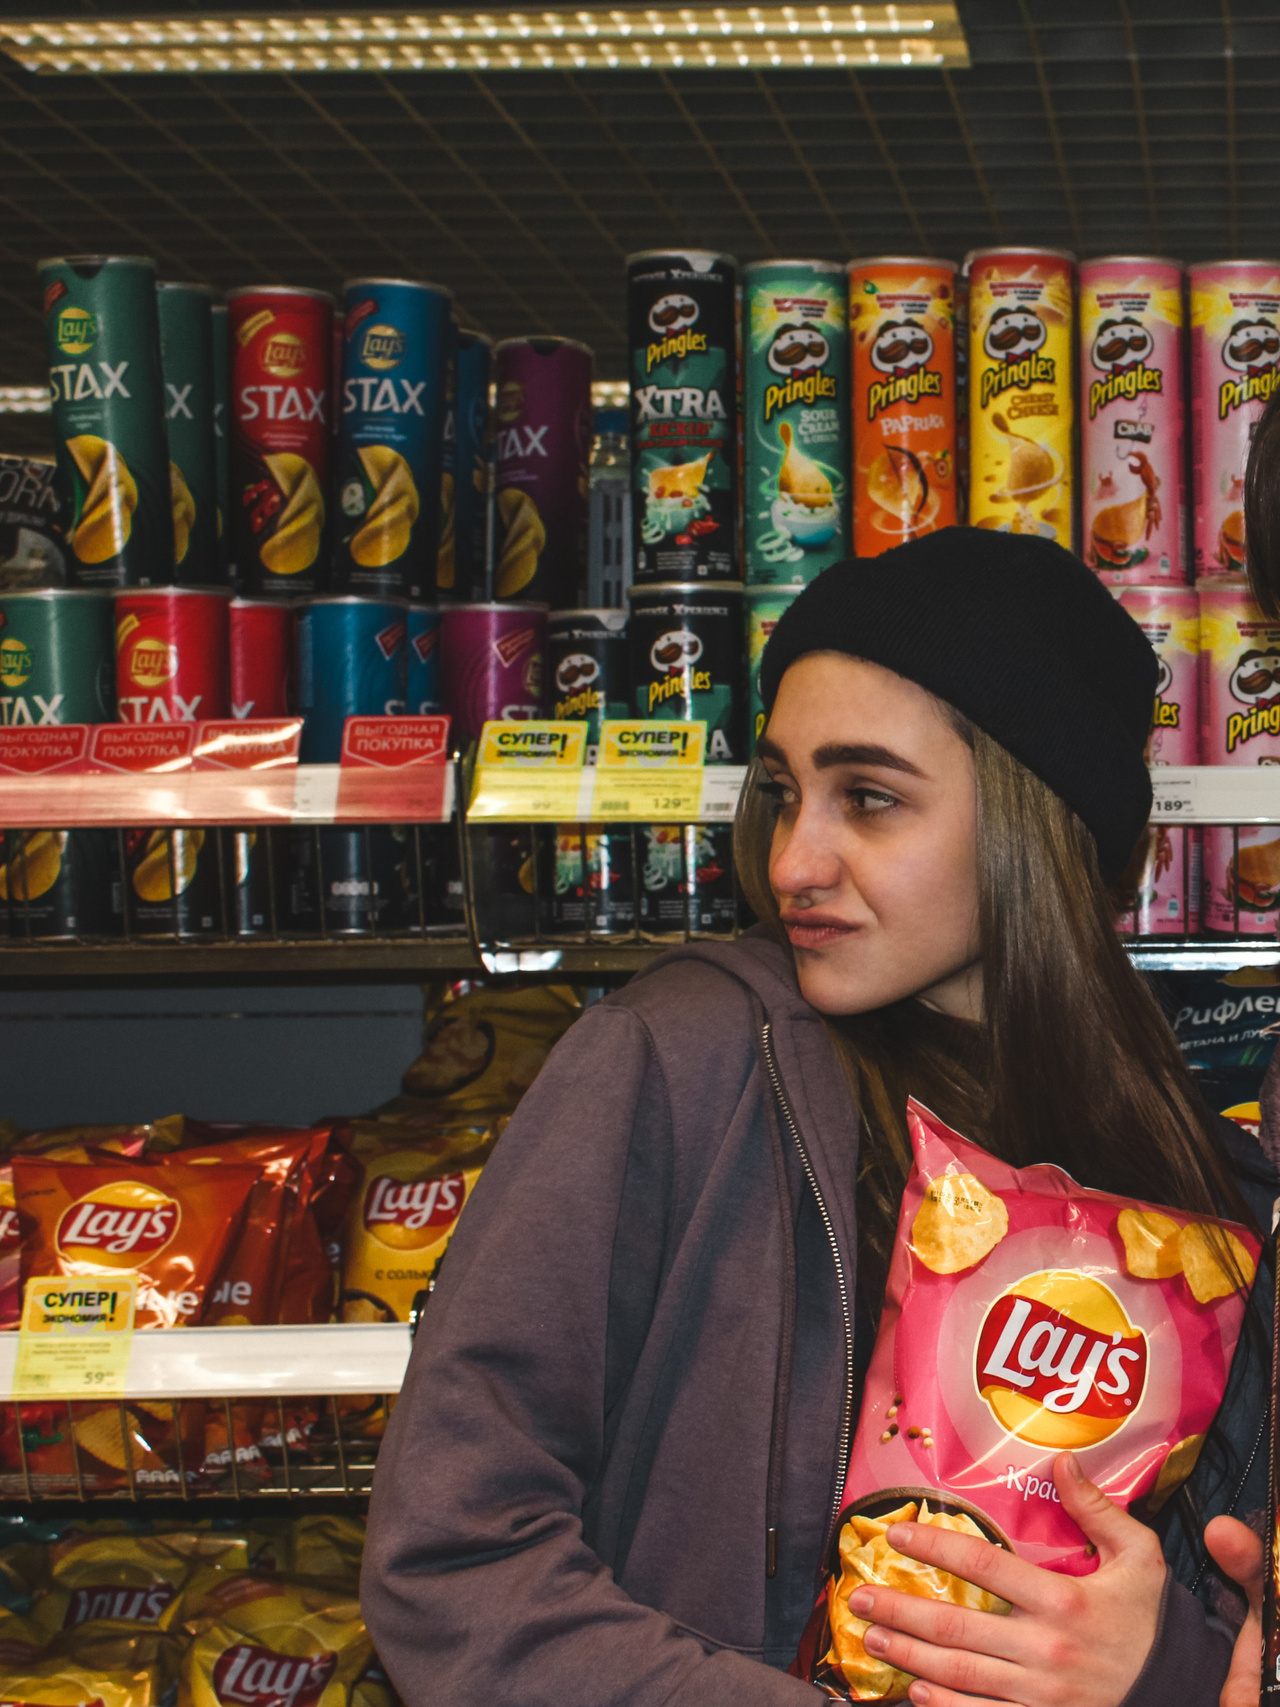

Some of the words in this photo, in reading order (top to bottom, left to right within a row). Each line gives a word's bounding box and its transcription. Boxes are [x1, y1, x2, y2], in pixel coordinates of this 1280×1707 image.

[646, 329, 707, 374] Pringles
[50, 361, 131, 402] STAX
[343, 377, 427, 417] STAX
[765, 367, 837, 420] Pringles
[868, 369, 942, 421] Pringles
[981, 357, 1056, 408] Pringles
[1089, 366, 1163, 420] Pringles
[241, 385, 326, 424] STAX
[634, 385, 727, 421] XTRA
[880, 413, 945, 437] PAPRIKA
[499, 425, 548, 458] TAX
[0, 694, 64, 726] TAX
[103, 731, 185, 744] ВЫГОДНАЯ
[355, 723, 439, 737] ВЫГОДНАЯ
[357, 738, 435, 752] ПОКУПКА
[498, 732, 568, 758] СУПЕР!
[618, 731, 689, 757] СУПЕР!
[103, 745, 180, 758] ПОКУПКА
[217, 742, 287, 754] ОКУПКА
[653, 798, 681, 809] 129
[1155, 800, 1182, 812] 189
[367, 1174, 461, 1229] Lay's
[62, 1204, 174, 1253] Lay's
[43, 1313, 108, 1323] ЭКОНОМИЯ
[45, 1291, 118, 1322] СУПЕР!
[983, 1298, 1140, 1413] Lay's
[84, 1371, 104, 1384] 59
[221, 1647, 334, 1707] Lay's
